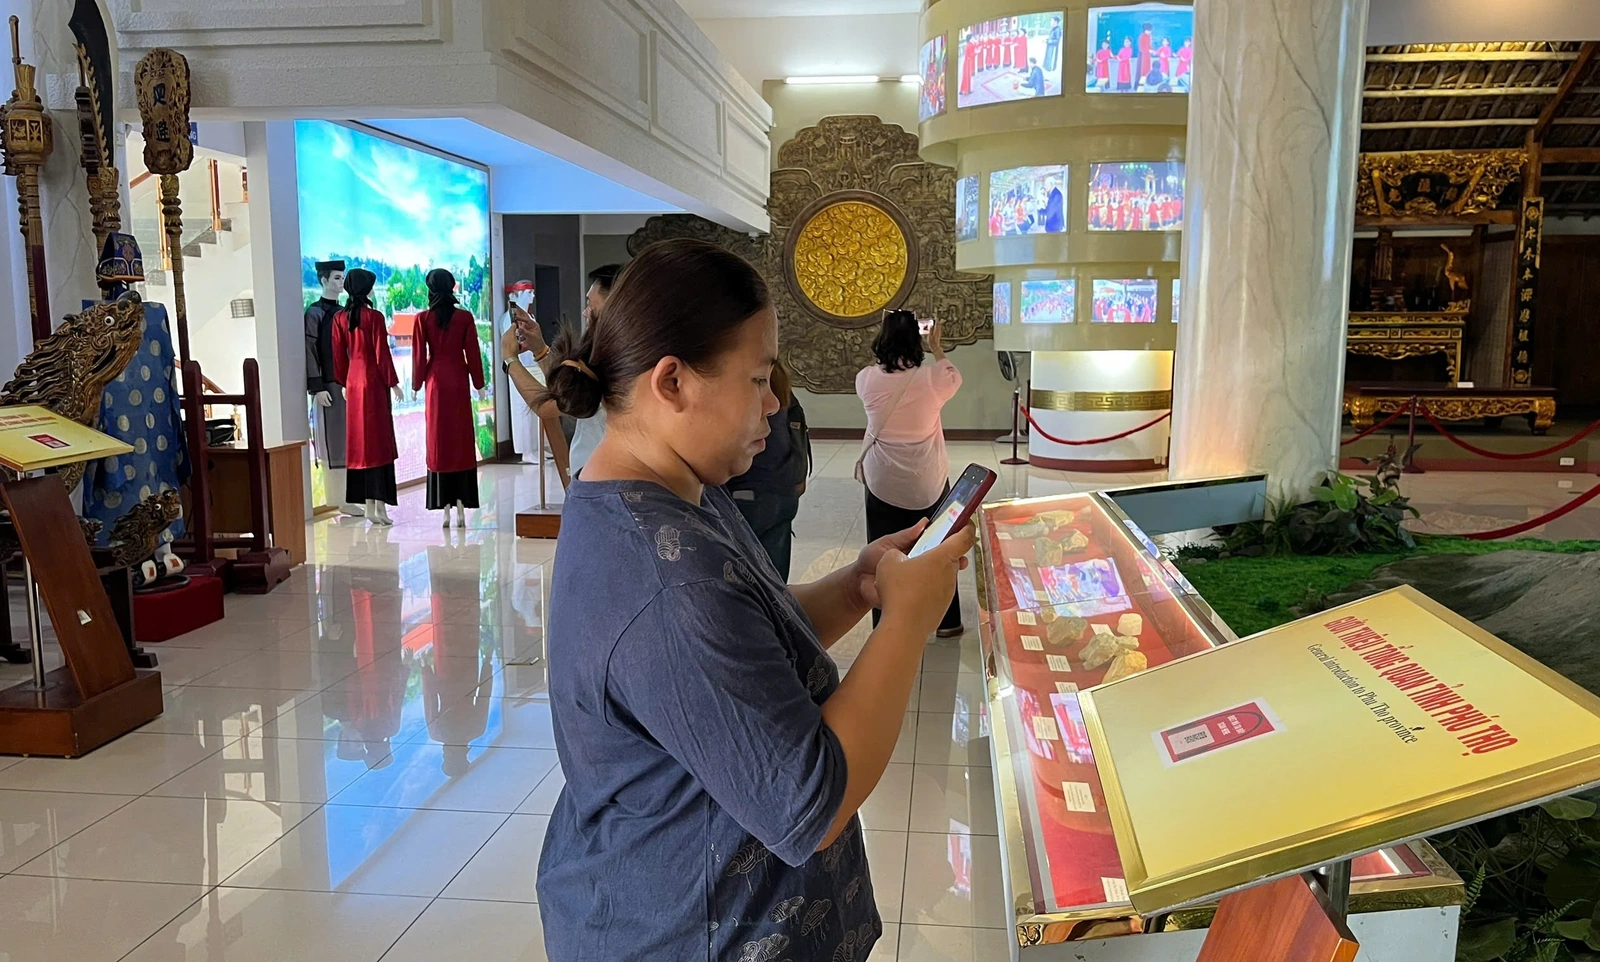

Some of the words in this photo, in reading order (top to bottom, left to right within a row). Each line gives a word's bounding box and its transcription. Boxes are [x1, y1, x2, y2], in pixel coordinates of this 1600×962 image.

[1338, 626, 1388, 651] THIỆU
[1307, 643, 1335, 662] General
[1359, 644, 1414, 670] TỔNG
[1323, 659, 1359, 689] introduction
[1378, 663, 1438, 691] QUAN
[1358, 692, 1377, 706] Phu
[1370, 702, 1390, 717] Tho
[1406, 683, 1464, 712] TỈNH
[1377, 716, 1418, 743] province
[1430, 703, 1500, 732] PHÚ
[1457, 724, 1518, 756] THỌ
